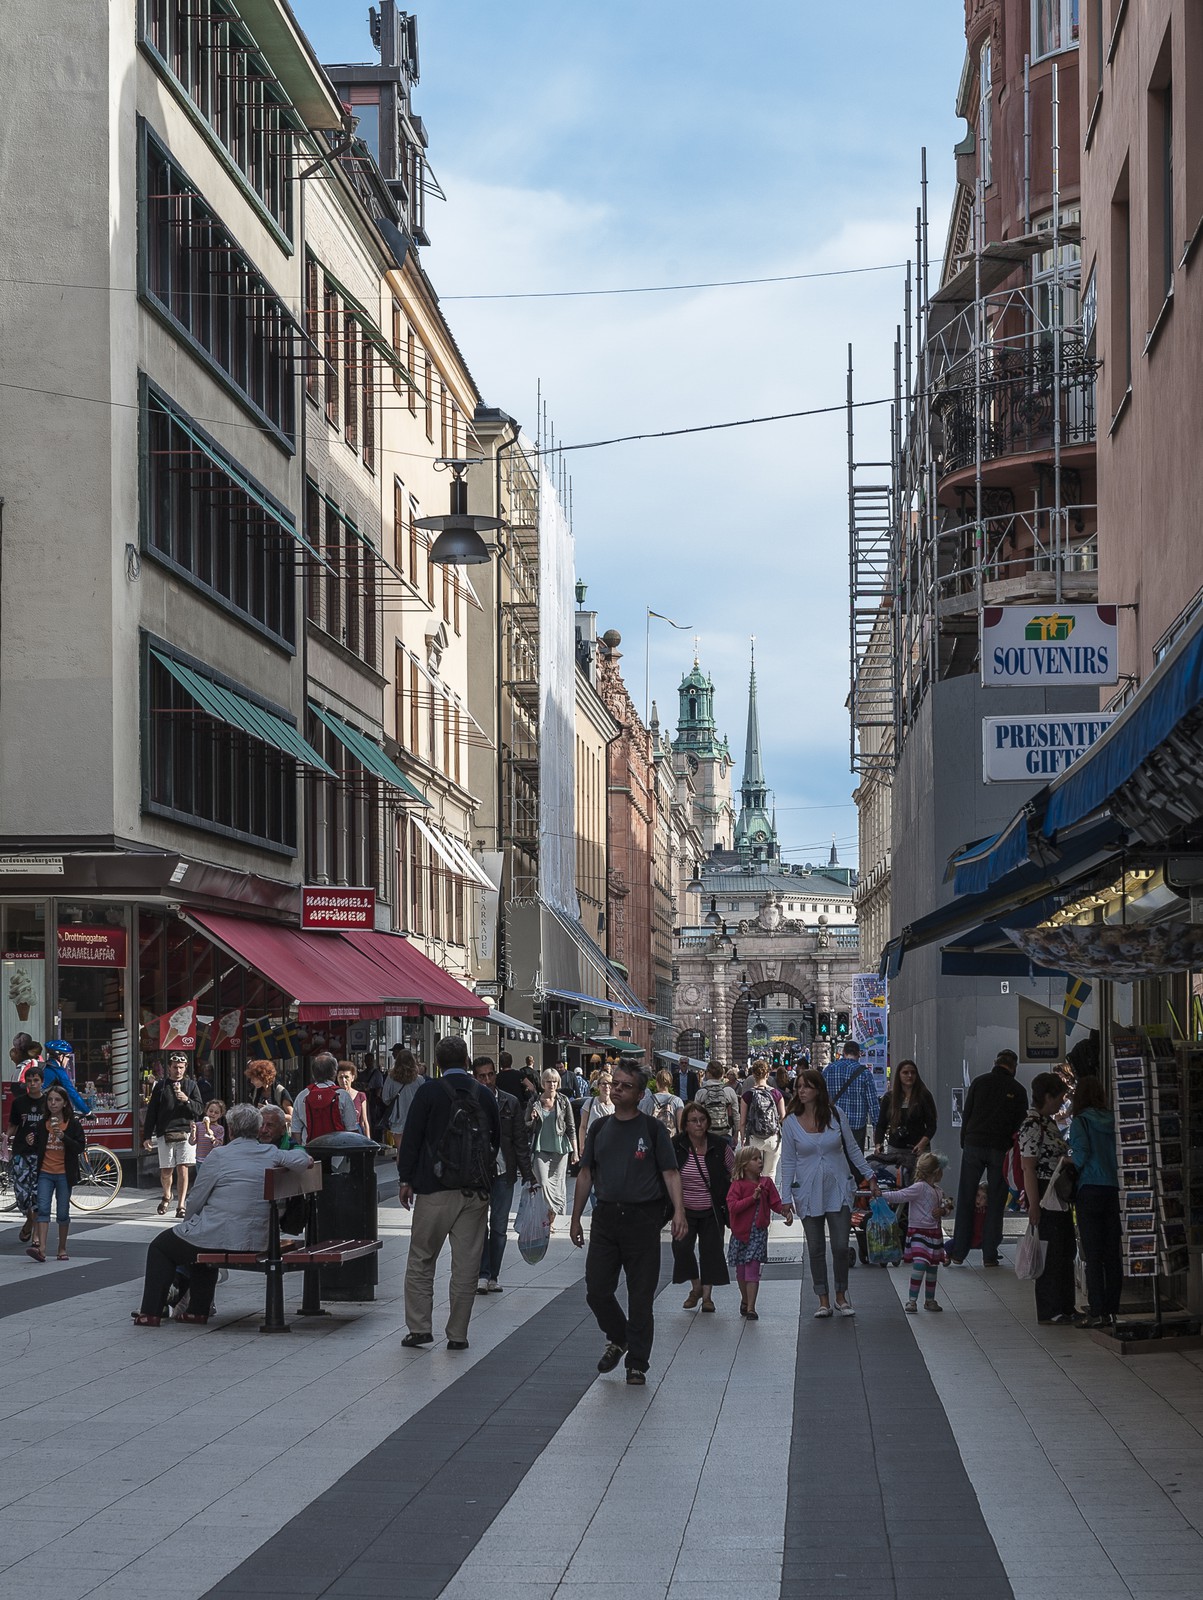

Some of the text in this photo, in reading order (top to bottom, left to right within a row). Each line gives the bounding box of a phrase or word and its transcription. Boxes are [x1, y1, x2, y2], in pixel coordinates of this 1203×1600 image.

[993, 646, 1109, 675] SOUVENIRS
[306, 895, 372, 908] KARAMELL
[309, 908, 366, 921] AFFÄREN
[64, 931, 108, 944] Drottninggatans
